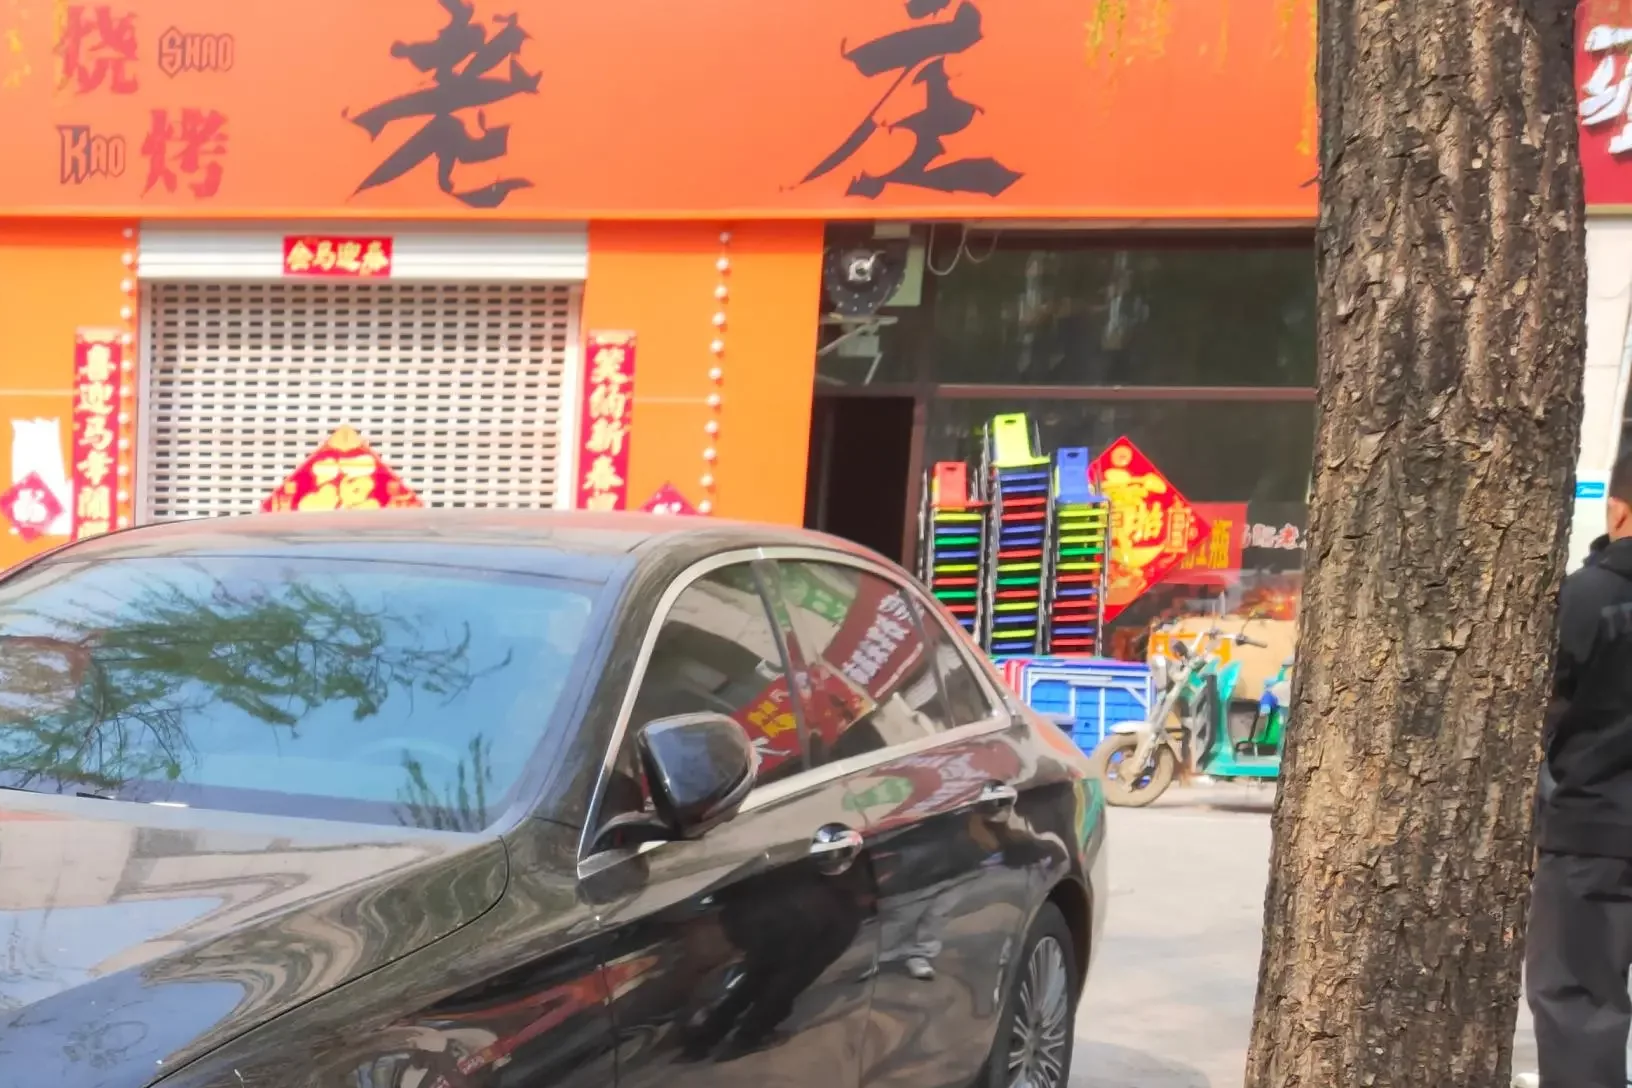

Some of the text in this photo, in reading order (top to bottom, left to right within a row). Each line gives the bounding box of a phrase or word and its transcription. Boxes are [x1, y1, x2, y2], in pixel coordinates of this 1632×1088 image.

[52, 5, 138, 95] 烧
[341, 0, 544, 208] 老
[779, 0, 1026, 197] 庄
[139, 107, 229, 199] 烤
